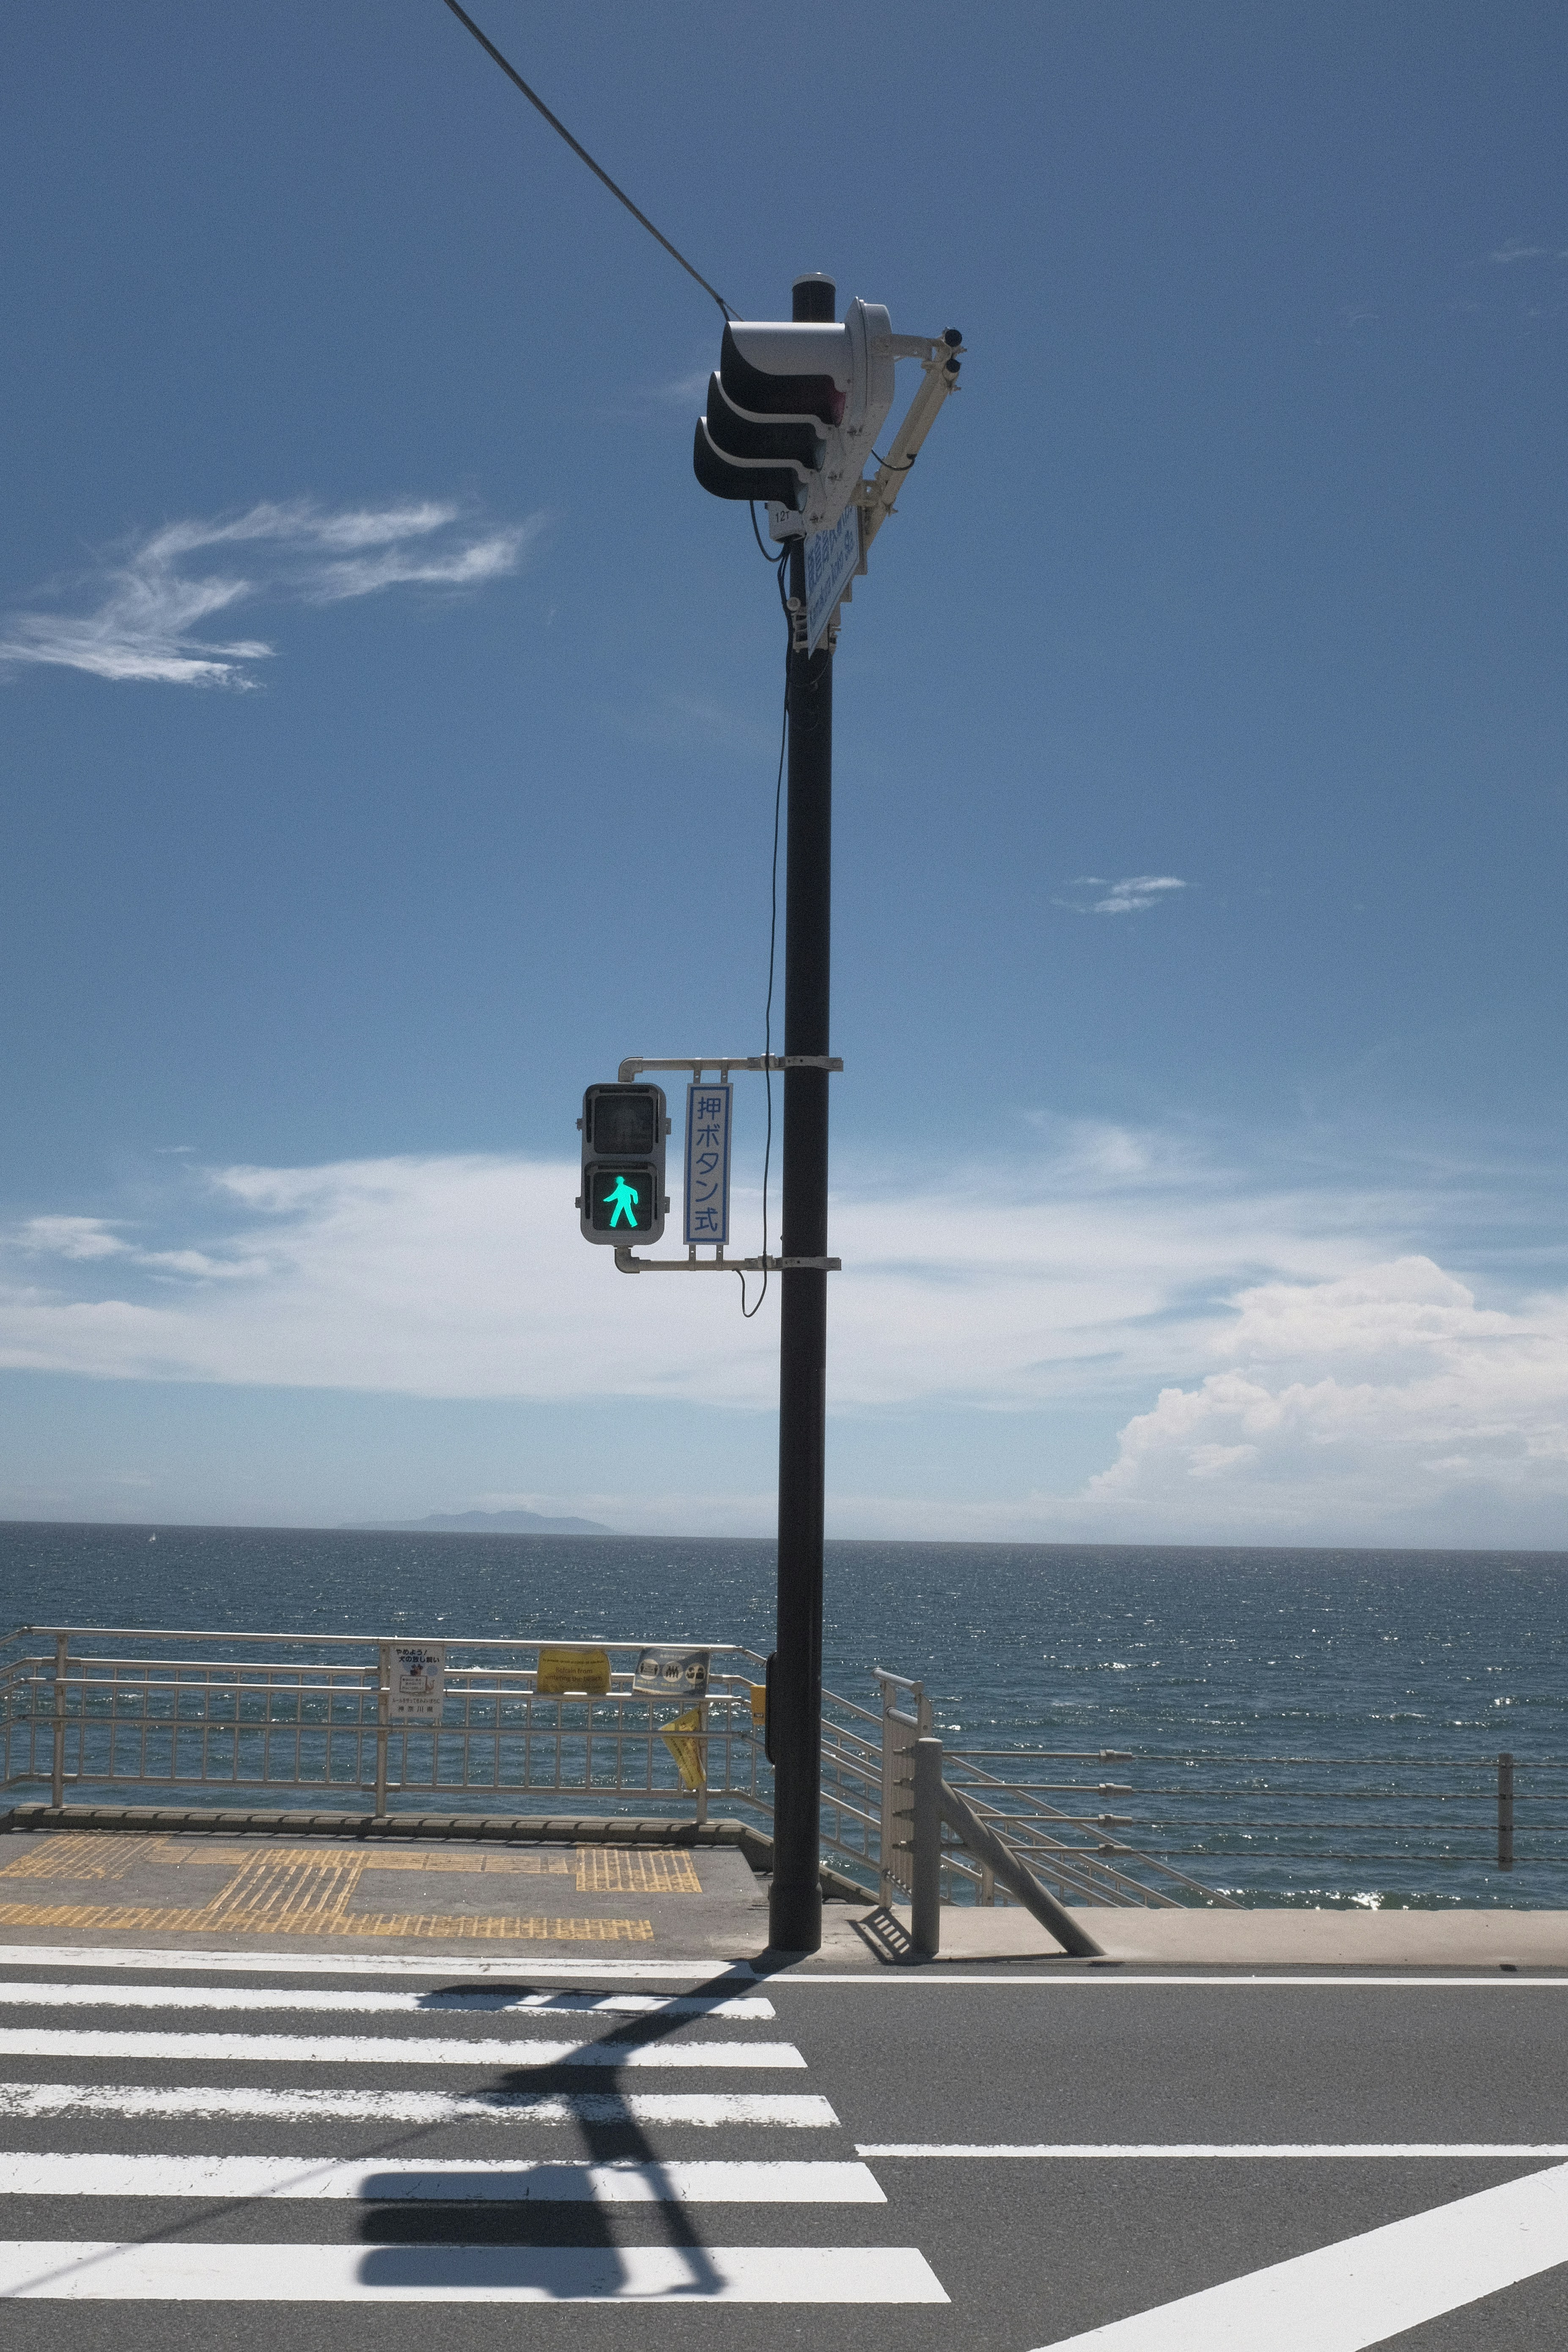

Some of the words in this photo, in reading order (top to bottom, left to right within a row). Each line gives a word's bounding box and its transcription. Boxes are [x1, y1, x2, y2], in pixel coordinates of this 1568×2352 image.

[695, 1096, 721, 1232] 押ボタン式
